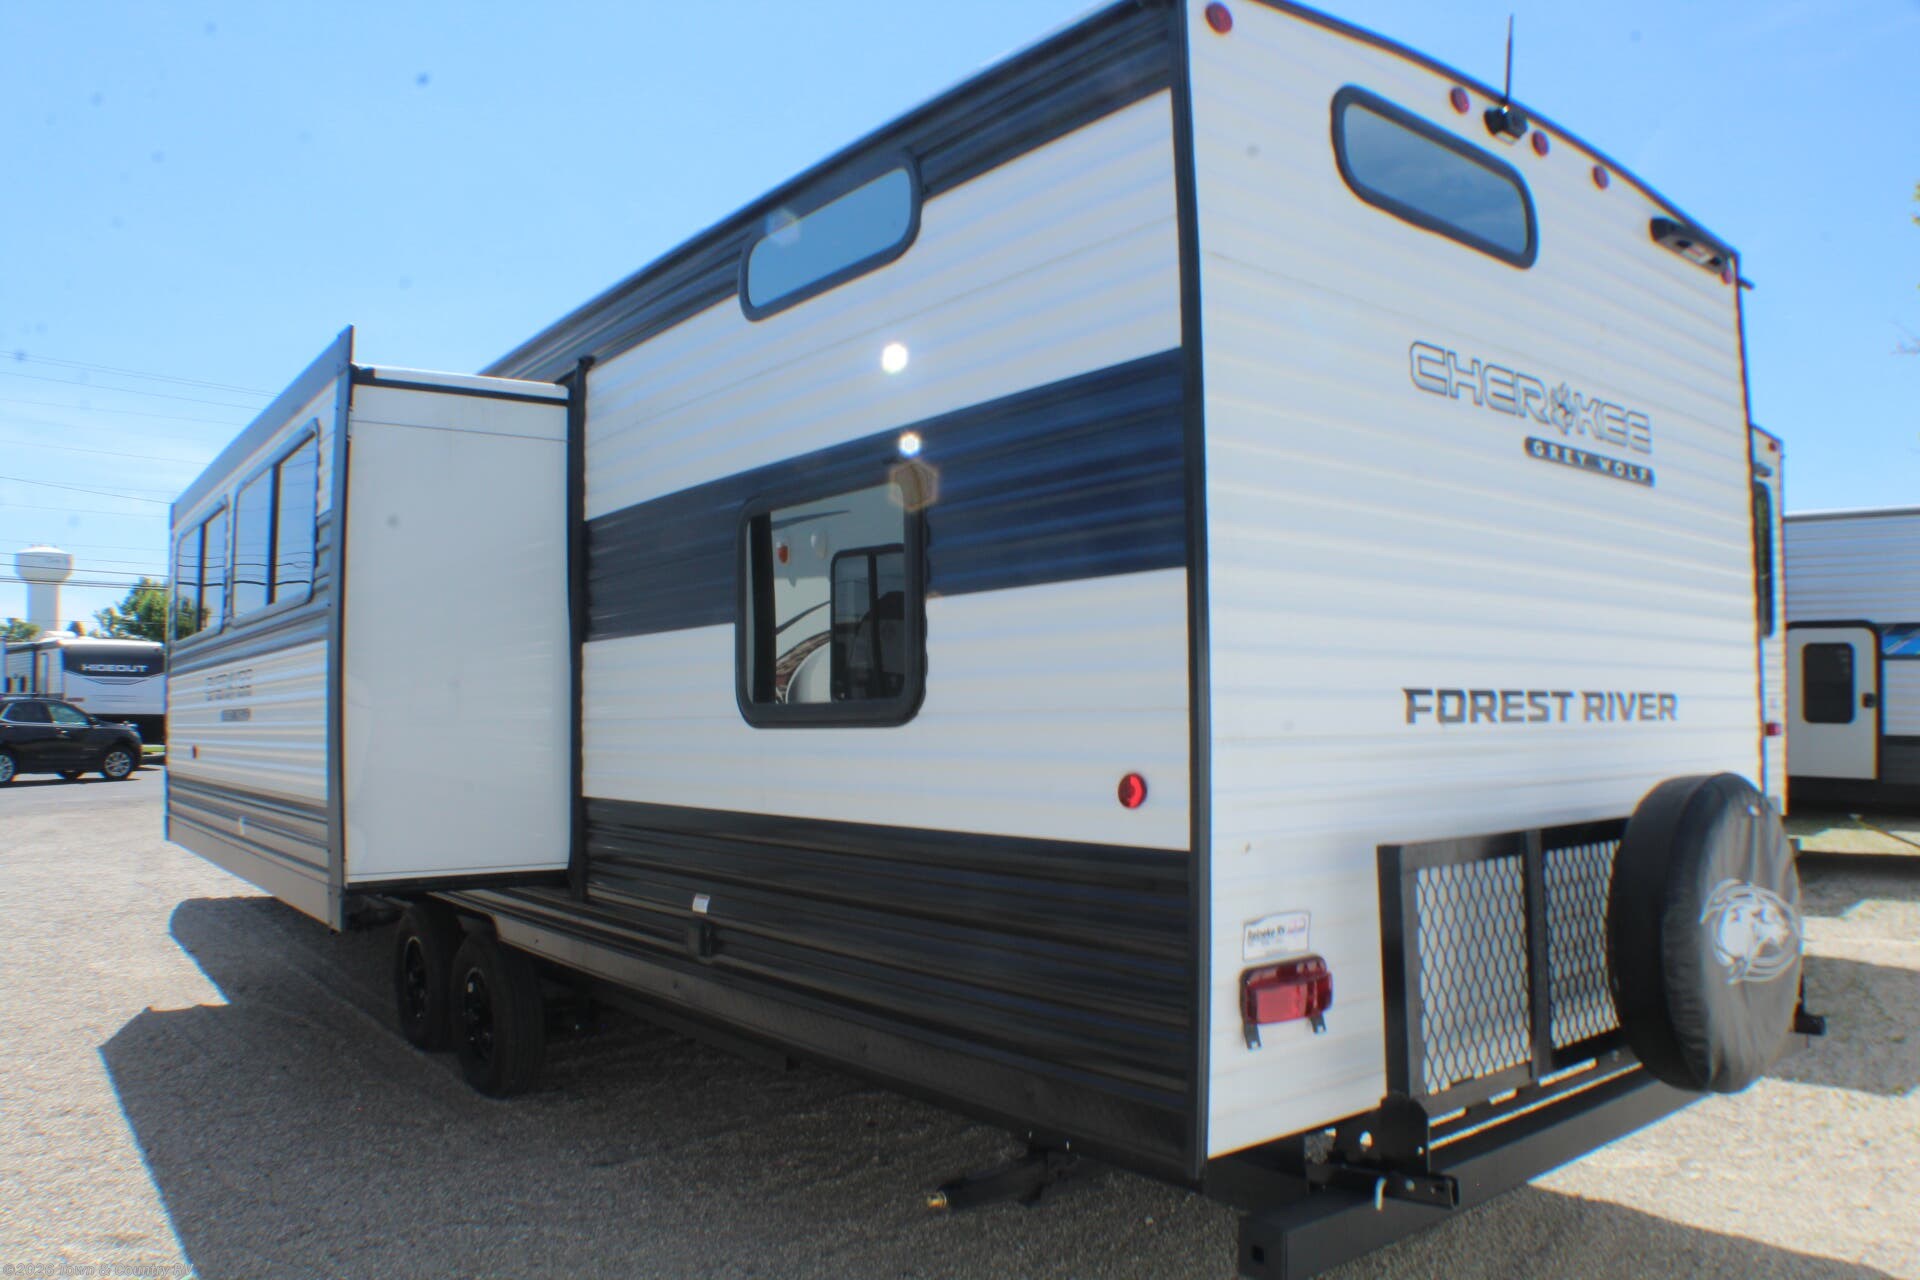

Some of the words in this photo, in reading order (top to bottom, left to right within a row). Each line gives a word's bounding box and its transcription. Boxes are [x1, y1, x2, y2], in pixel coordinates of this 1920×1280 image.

[1533, 439, 1586, 466] GREY
[1599, 457, 1649, 480] WOLF
[80, 664, 149, 673] HIDEOUT
[1402, 688, 1574, 724] FOREST
[1581, 691, 1678, 721] RIVER
